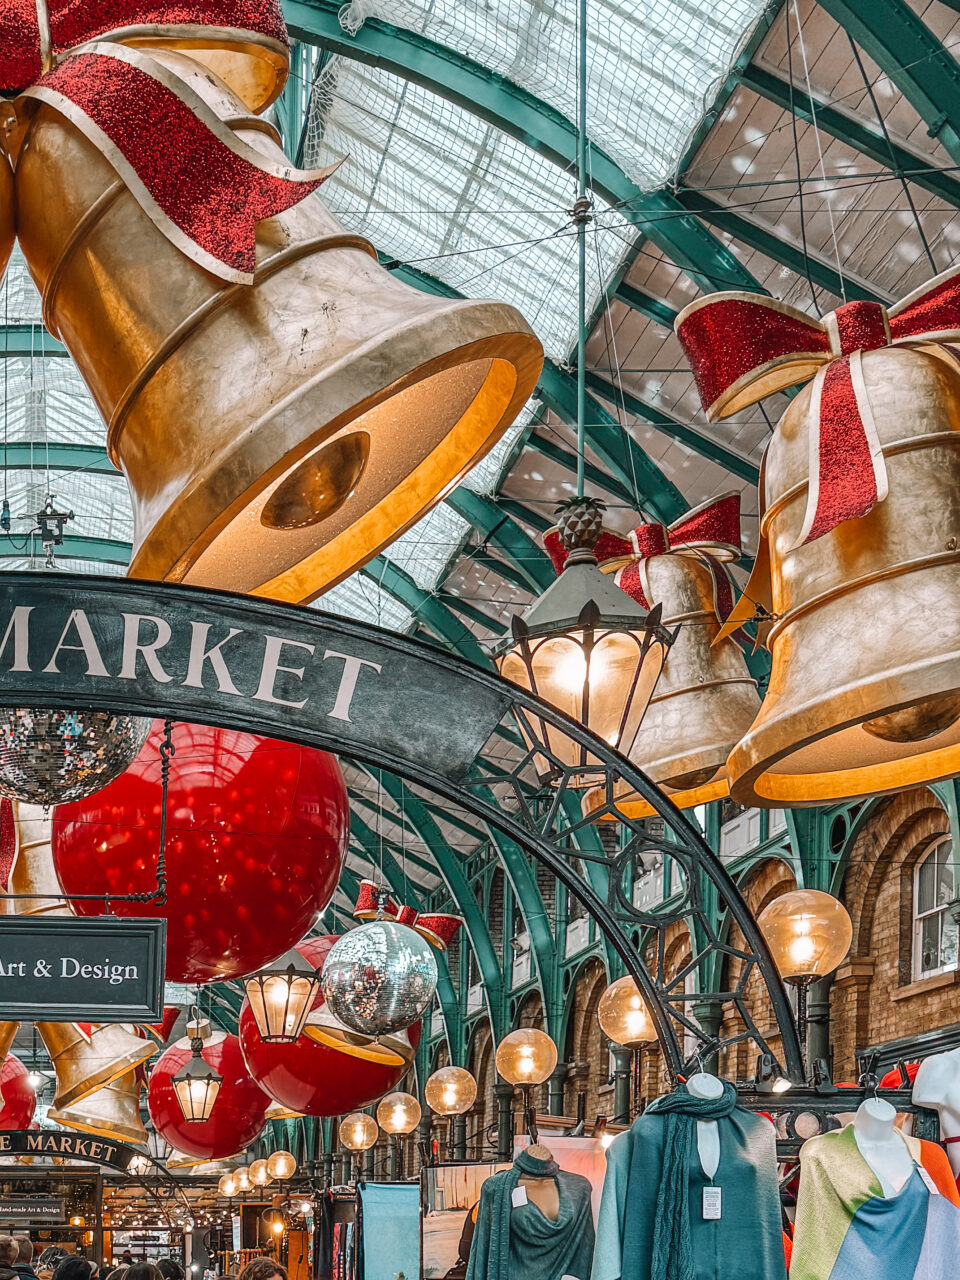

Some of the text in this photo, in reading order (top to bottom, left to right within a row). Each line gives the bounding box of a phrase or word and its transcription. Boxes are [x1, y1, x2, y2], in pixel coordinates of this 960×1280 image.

[33, 958, 52, 978] &
[59, 956, 139, 985] Design
[26, 1135, 117, 1162] MARKET
